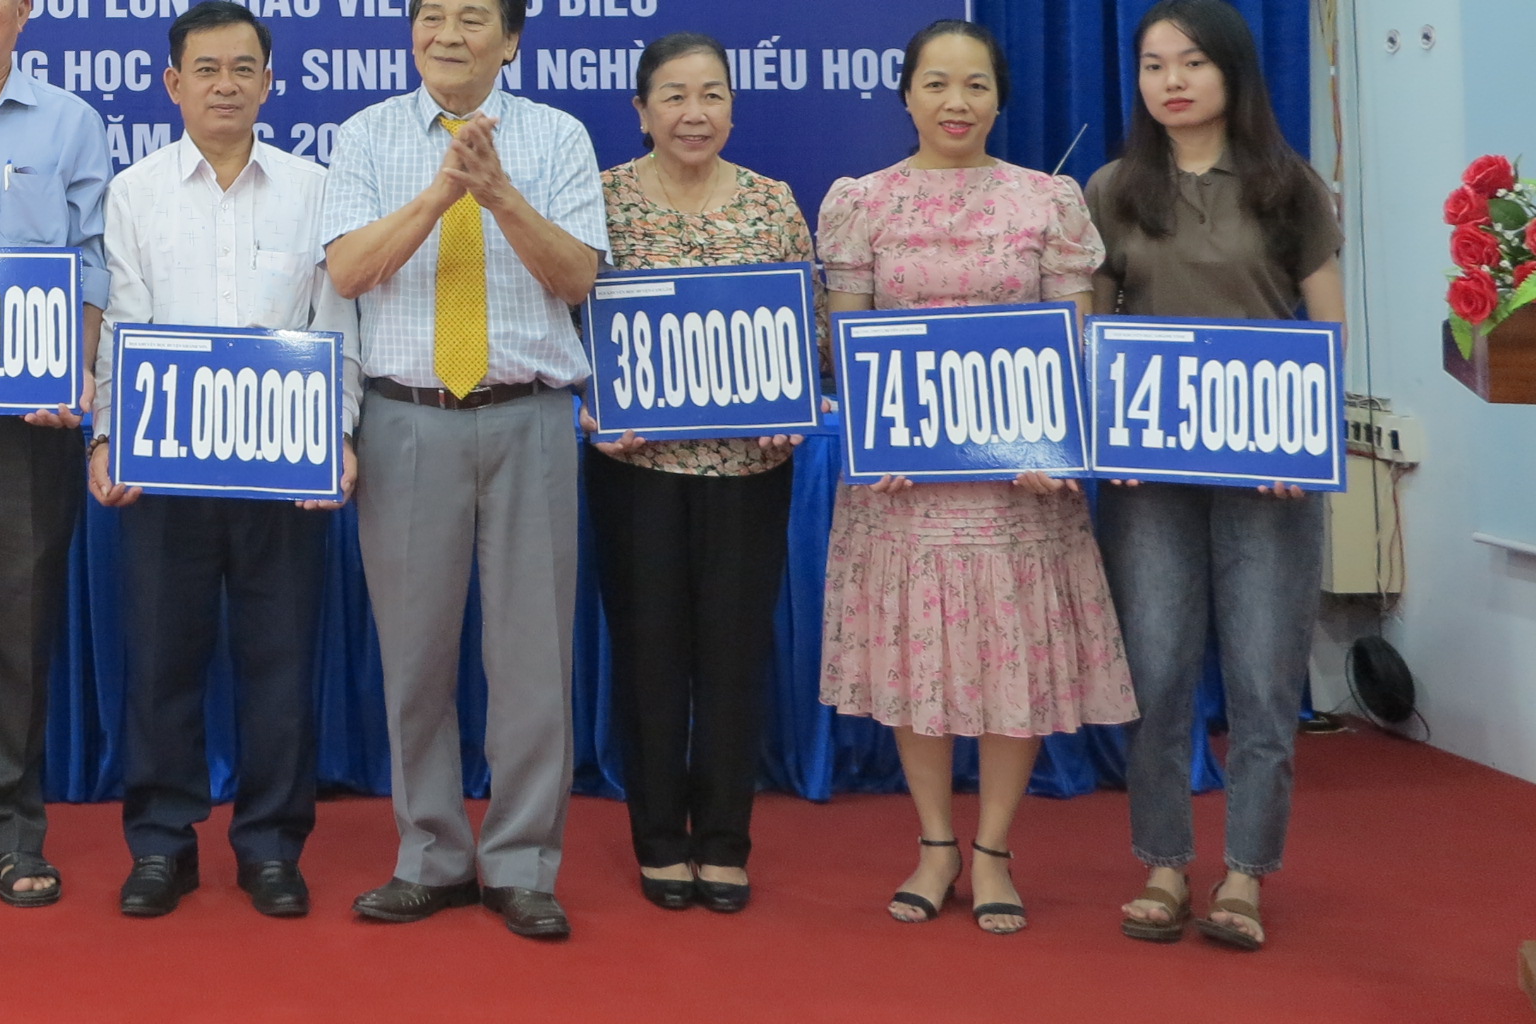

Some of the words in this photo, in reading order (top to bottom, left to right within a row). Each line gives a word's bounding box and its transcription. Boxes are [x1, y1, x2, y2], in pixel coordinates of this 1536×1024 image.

[64, 49, 152, 101] HỌC
[301, 49, 408, 91] SINH
[822, 48, 906, 99] HỌC
[106, 114, 171, 165] ĂM
[290, 122, 341, 164] 20
[611, 306, 802, 409] 38.000.000
[855, 347, 1067, 450] 74.500.000
[1108, 352, 1328, 456] 14.500.000
[133, 361, 327, 464] 21.000.000
